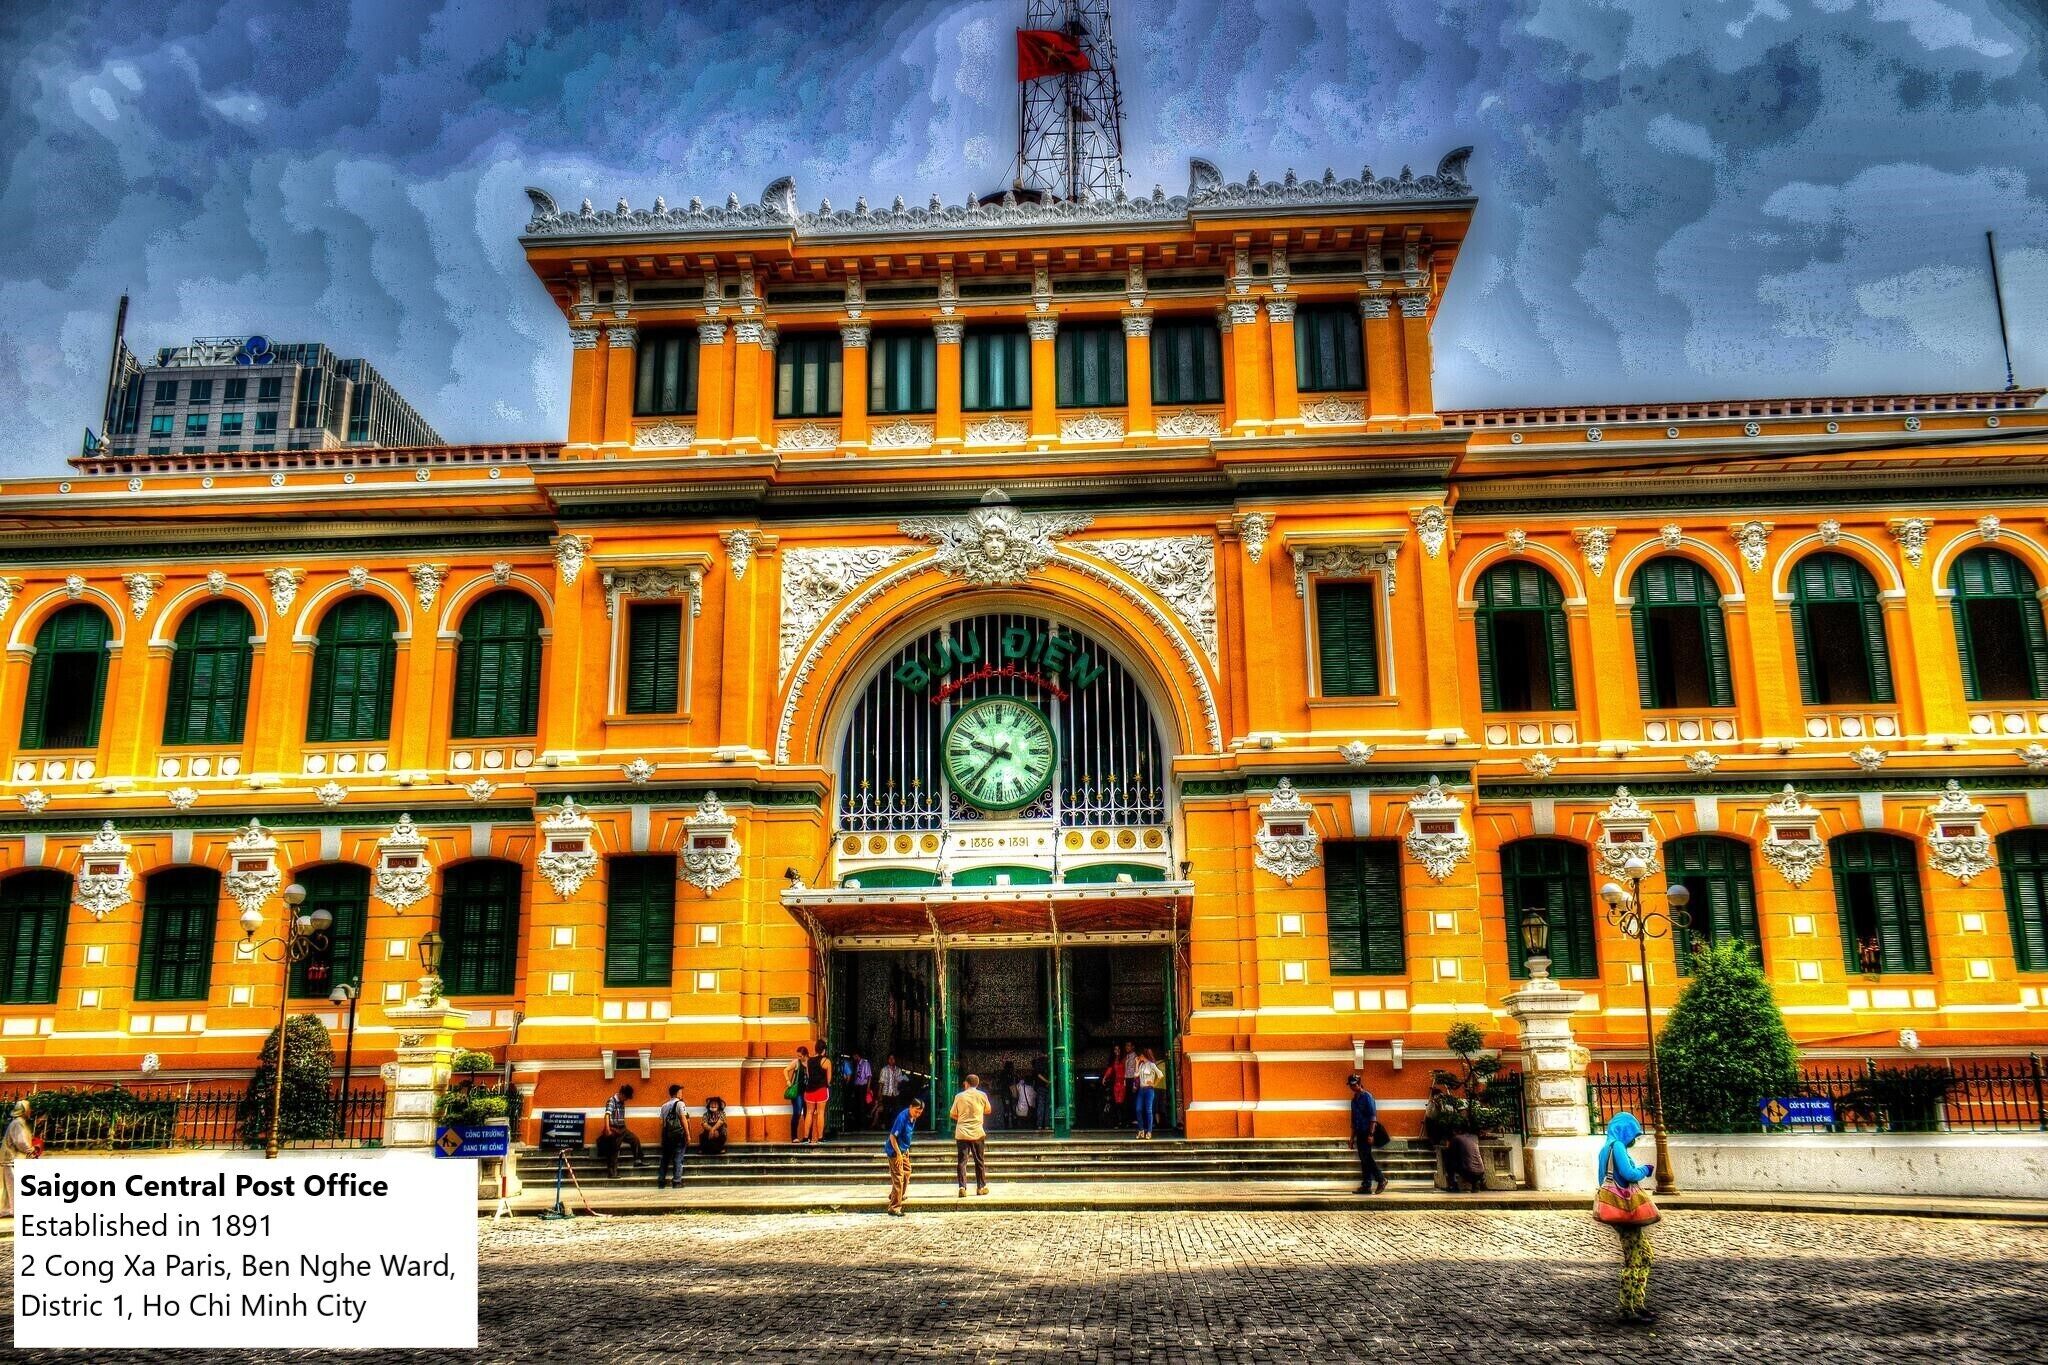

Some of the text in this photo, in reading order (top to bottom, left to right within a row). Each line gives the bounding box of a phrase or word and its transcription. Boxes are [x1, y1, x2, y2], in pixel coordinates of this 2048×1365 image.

[165, 346, 240, 367] ANZ
[971, 837, 1029, 848] 1886 1891
